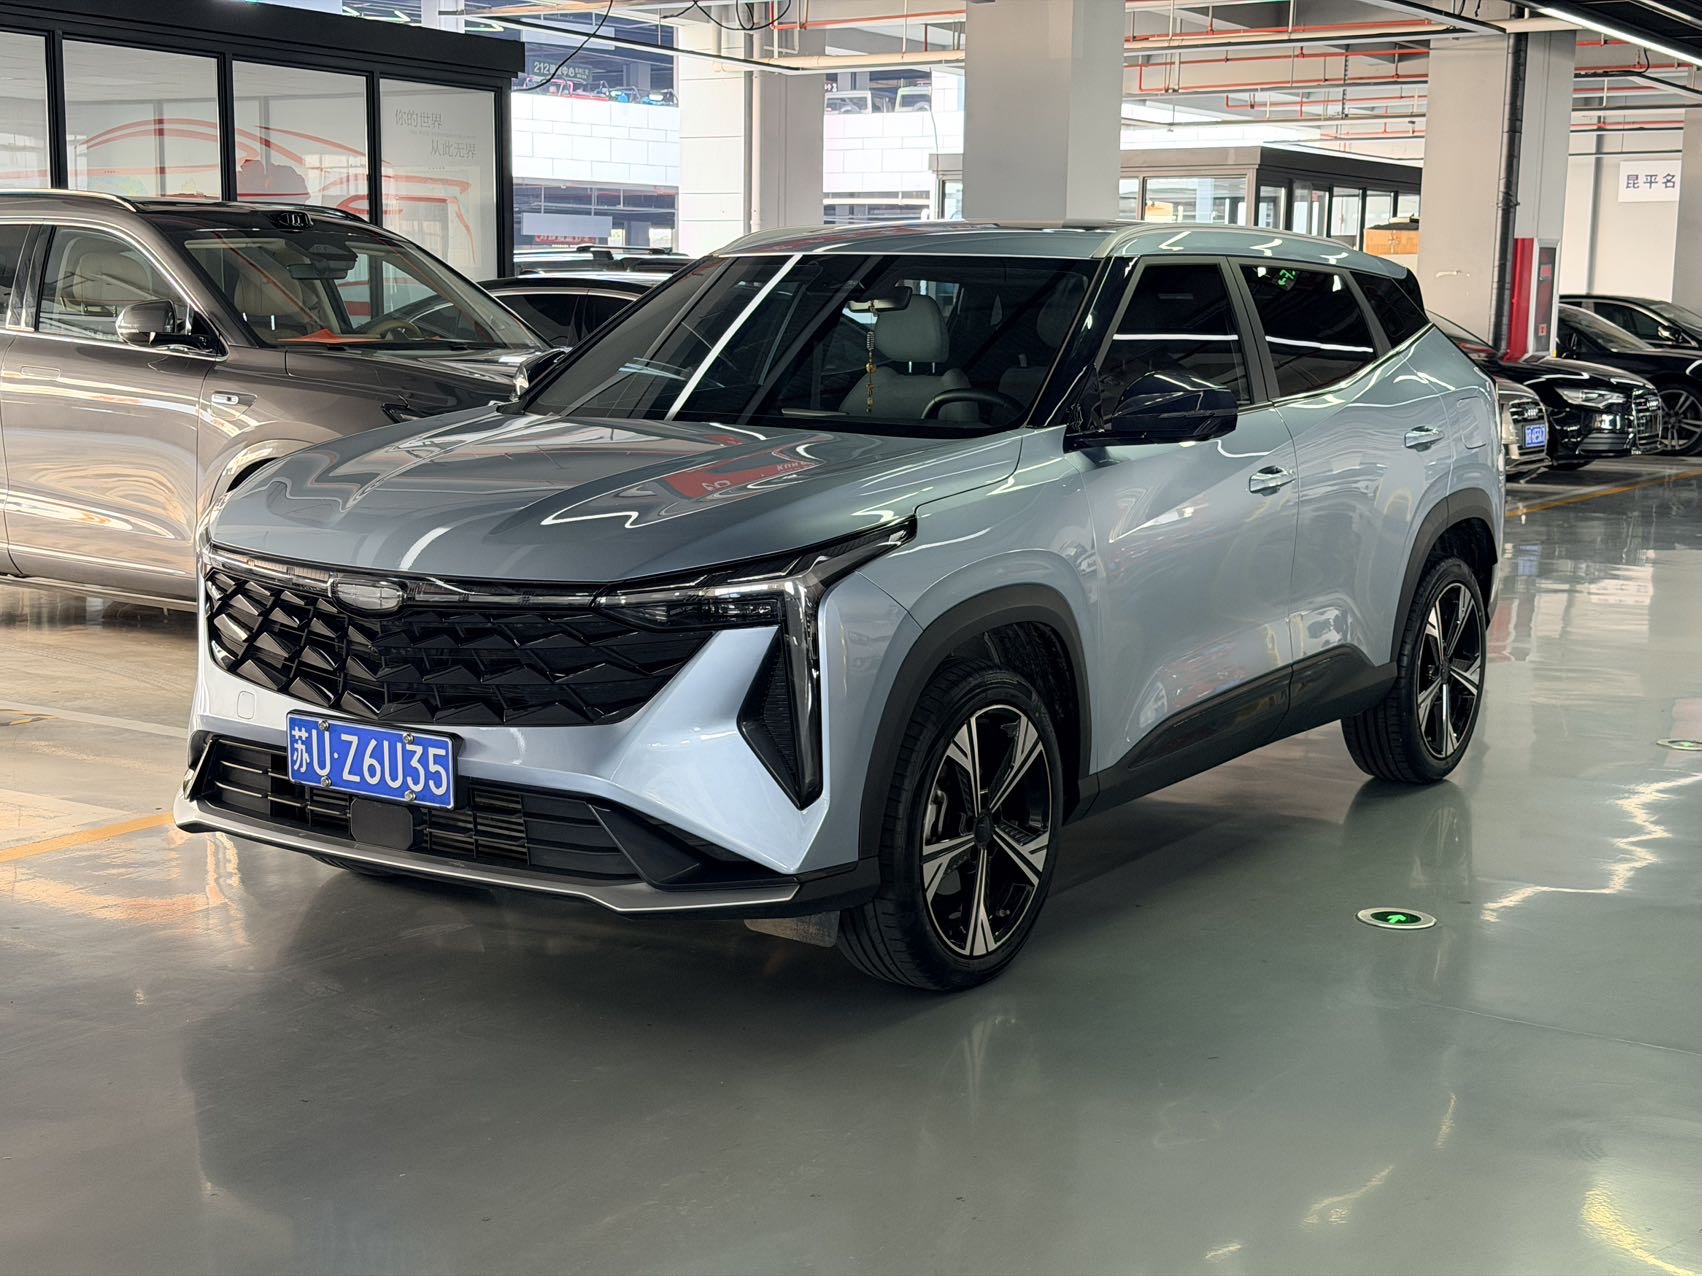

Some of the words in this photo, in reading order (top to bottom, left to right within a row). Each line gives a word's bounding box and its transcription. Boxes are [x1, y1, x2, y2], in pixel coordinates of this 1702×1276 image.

[395, 108, 442, 129] 你的世界
[430, 140, 477, 159] 从此无界
[1625, 173, 1676, 189] 昆平名
[291, 726, 448, 796] 苏U·Z6U35
